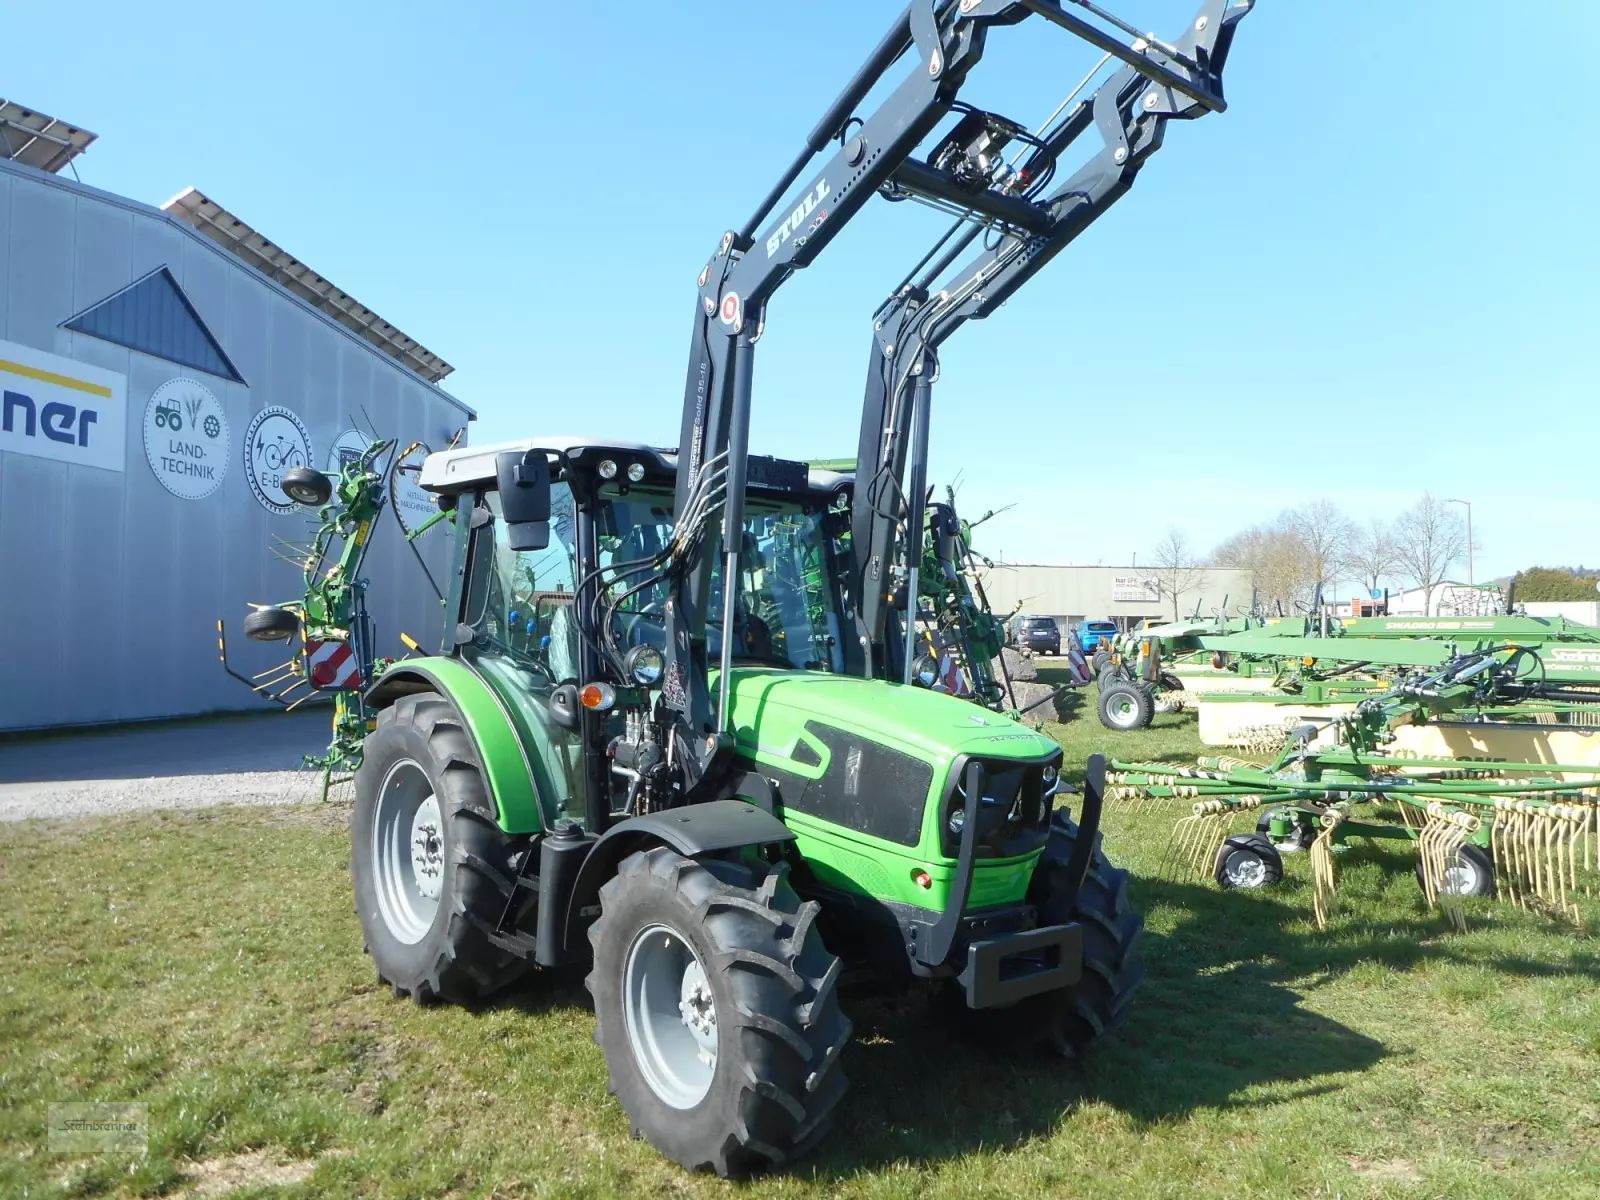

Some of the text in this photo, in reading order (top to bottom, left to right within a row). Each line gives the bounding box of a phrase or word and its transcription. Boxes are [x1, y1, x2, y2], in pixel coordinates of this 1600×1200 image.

[766, 177, 831, 260] STOLL
[2, 389, 98, 448] ner
[169, 439, 208, 459] LAND-
[160, 456, 215, 480] TECHNIK
[261, 471, 283, 489] E-B
